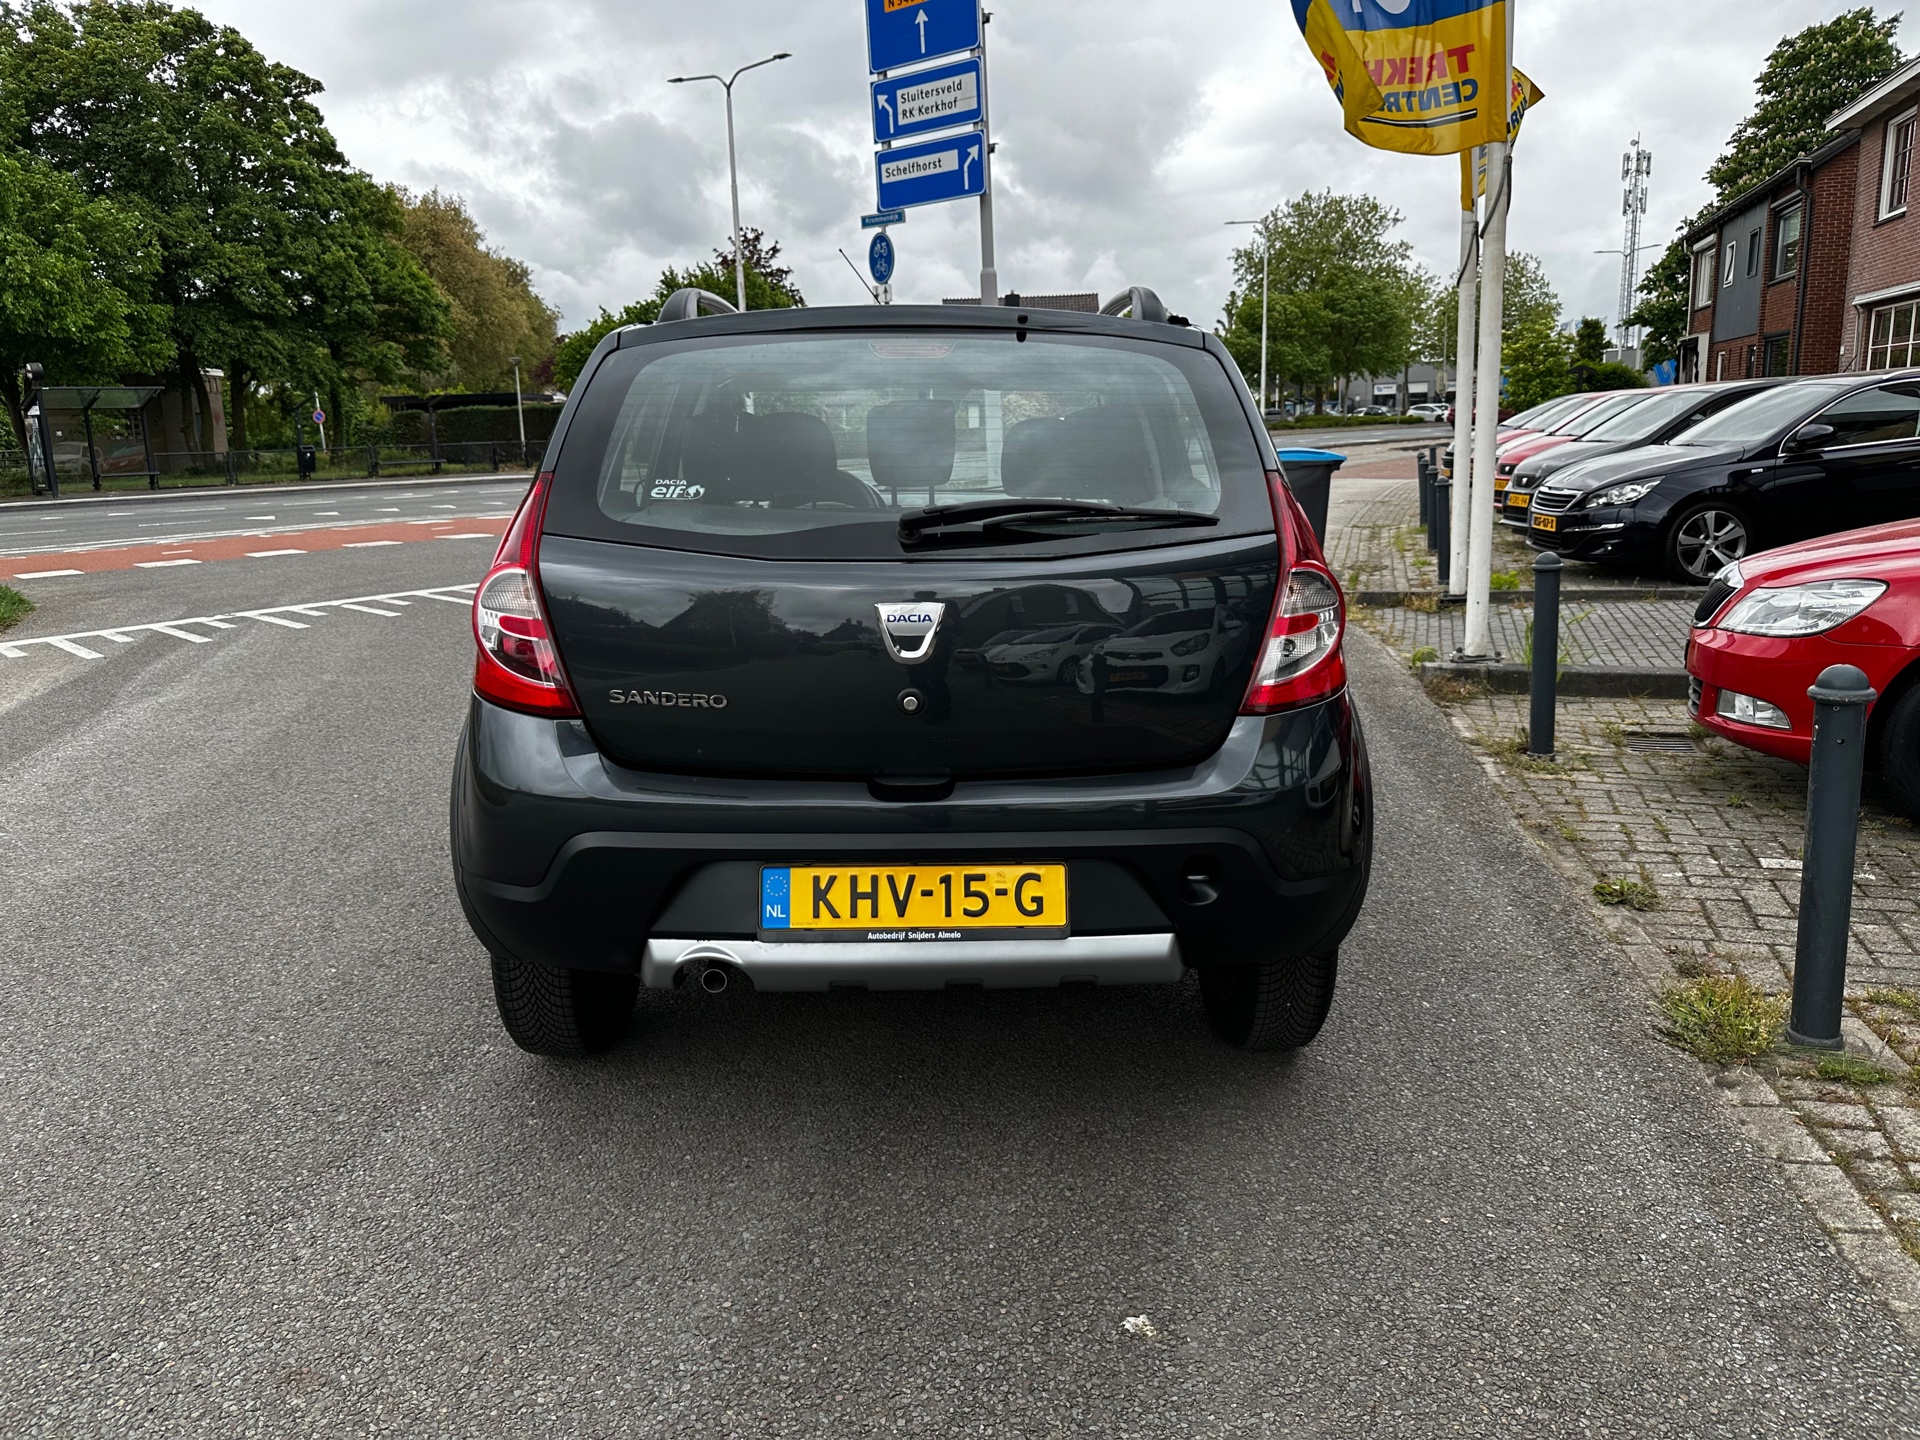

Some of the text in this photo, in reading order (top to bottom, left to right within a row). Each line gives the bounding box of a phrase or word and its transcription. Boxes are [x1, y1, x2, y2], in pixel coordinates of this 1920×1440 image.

[901, 79, 962, 104] Sluitersveld
[902, 96, 958, 120] RK Kerkhof
[885, 158, 942, 179] Schelfhorst
[650, 485, 686, 498] elf
[887, 614, 933, 623] DACIA
[608, 689, 729, 709] SANDERO
[813, 873, 1044, 919] KHV-15-G
[766, 905, 786, 918] NL
[867, 930, 961, 940] Autobedrijf Snijders Almelo
